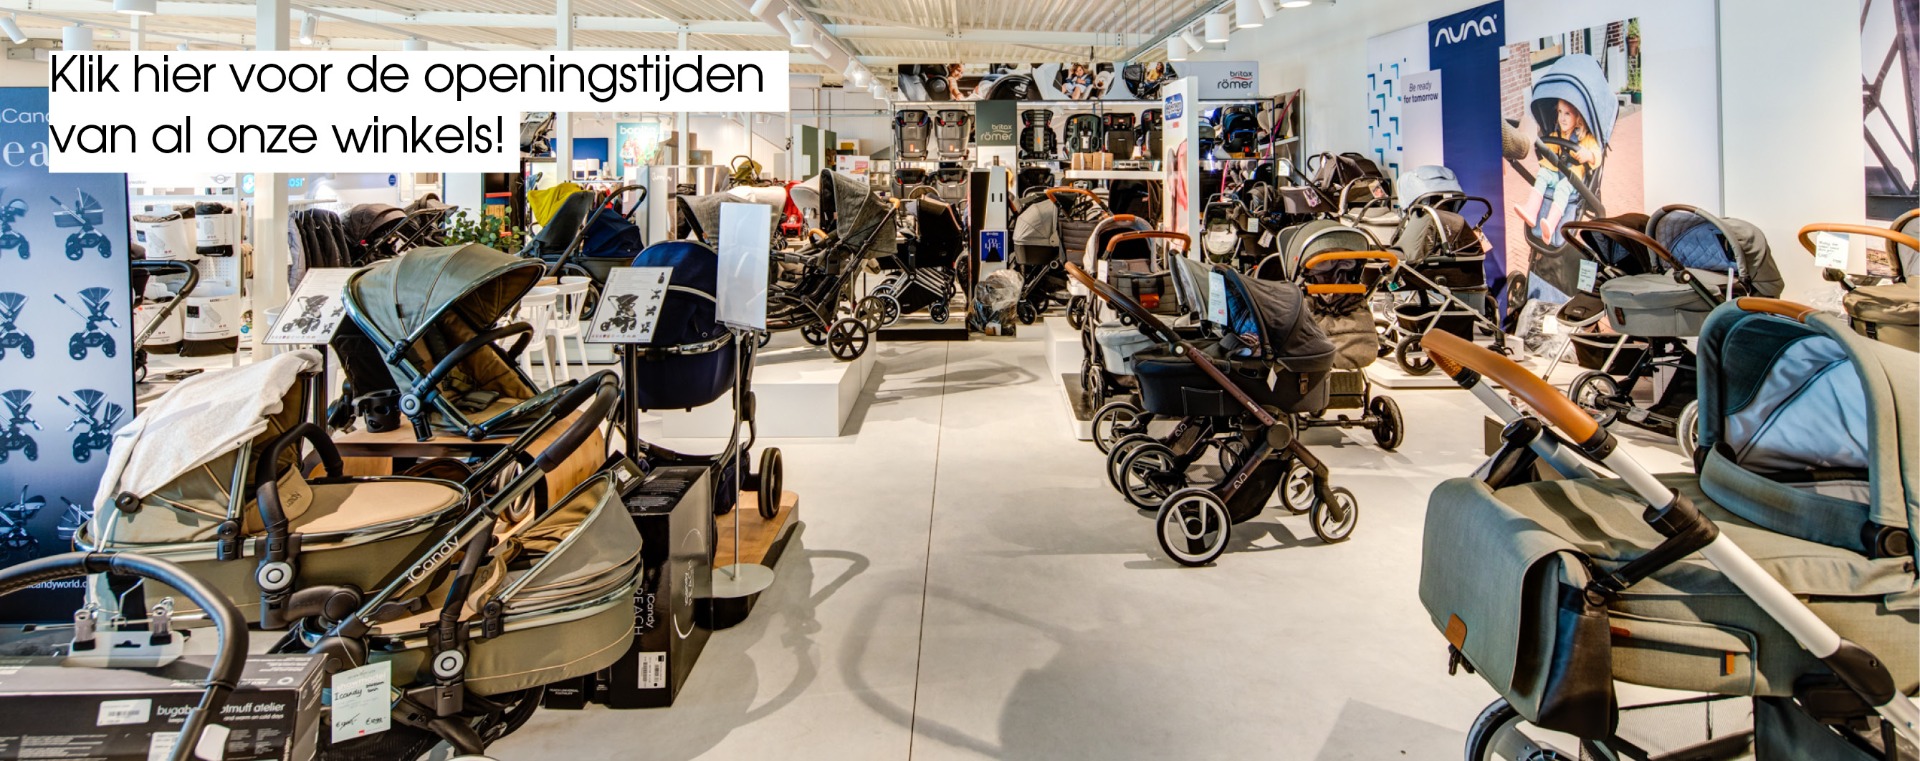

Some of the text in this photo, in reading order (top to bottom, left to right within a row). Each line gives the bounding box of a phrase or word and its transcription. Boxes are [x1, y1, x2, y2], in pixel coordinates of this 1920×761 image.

[1434, 15, 1497, 48] nuna
[1217, 79, 1253, 89] römer
[1408, 80, 1432, 92] Be ready
[1403, 92, 1438, 104] for tomorrow
[980, 131, 1012, 141] römer
[406, 535, 460, 583] iCandy
[646, 593, 655, 629] iCandy
[156, 704, 200, 717] bugabo
[253, 702, 286, 713] atelier
